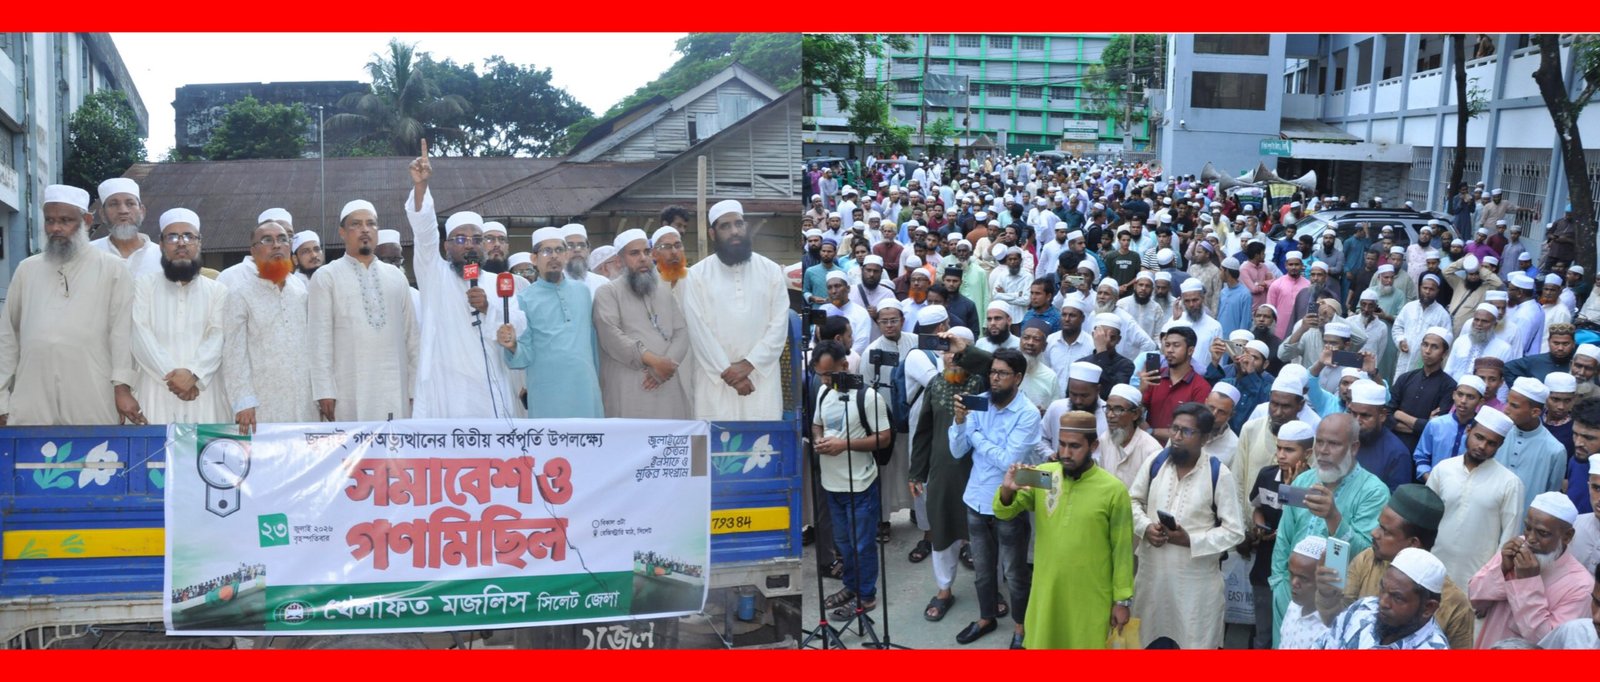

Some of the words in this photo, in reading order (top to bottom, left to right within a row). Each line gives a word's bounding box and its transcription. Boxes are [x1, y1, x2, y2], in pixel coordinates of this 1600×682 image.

[451, 428, 492, 448] দ্বিতীয়
[496, 428, 544, 452] বর্ষপূর্তি
[547, 430, 604, 448] উপলক্ষ্যে
[663, 446, 689, 457] চেতনা
[681, 457, 689, 467] ও
[344, 456, 535, 506] সমাবেশ
[536, 457, 573, 504] ও
[635, 466, 661, 482] মুক্তির
[662, 468, 689, 478] সংগ্রাম
[261, 522, 287, 541] ২৩
[346, 504, 568, 570] গণমিছিল
[324, 595, 434, 620] খেলাফত
[439, 584, 531, 616] মজলিস
[537, 591, 581, 612] সিলেট
[584, 590, 620, 609] জেলা
[1228, 590, 1244, 602] EASY
